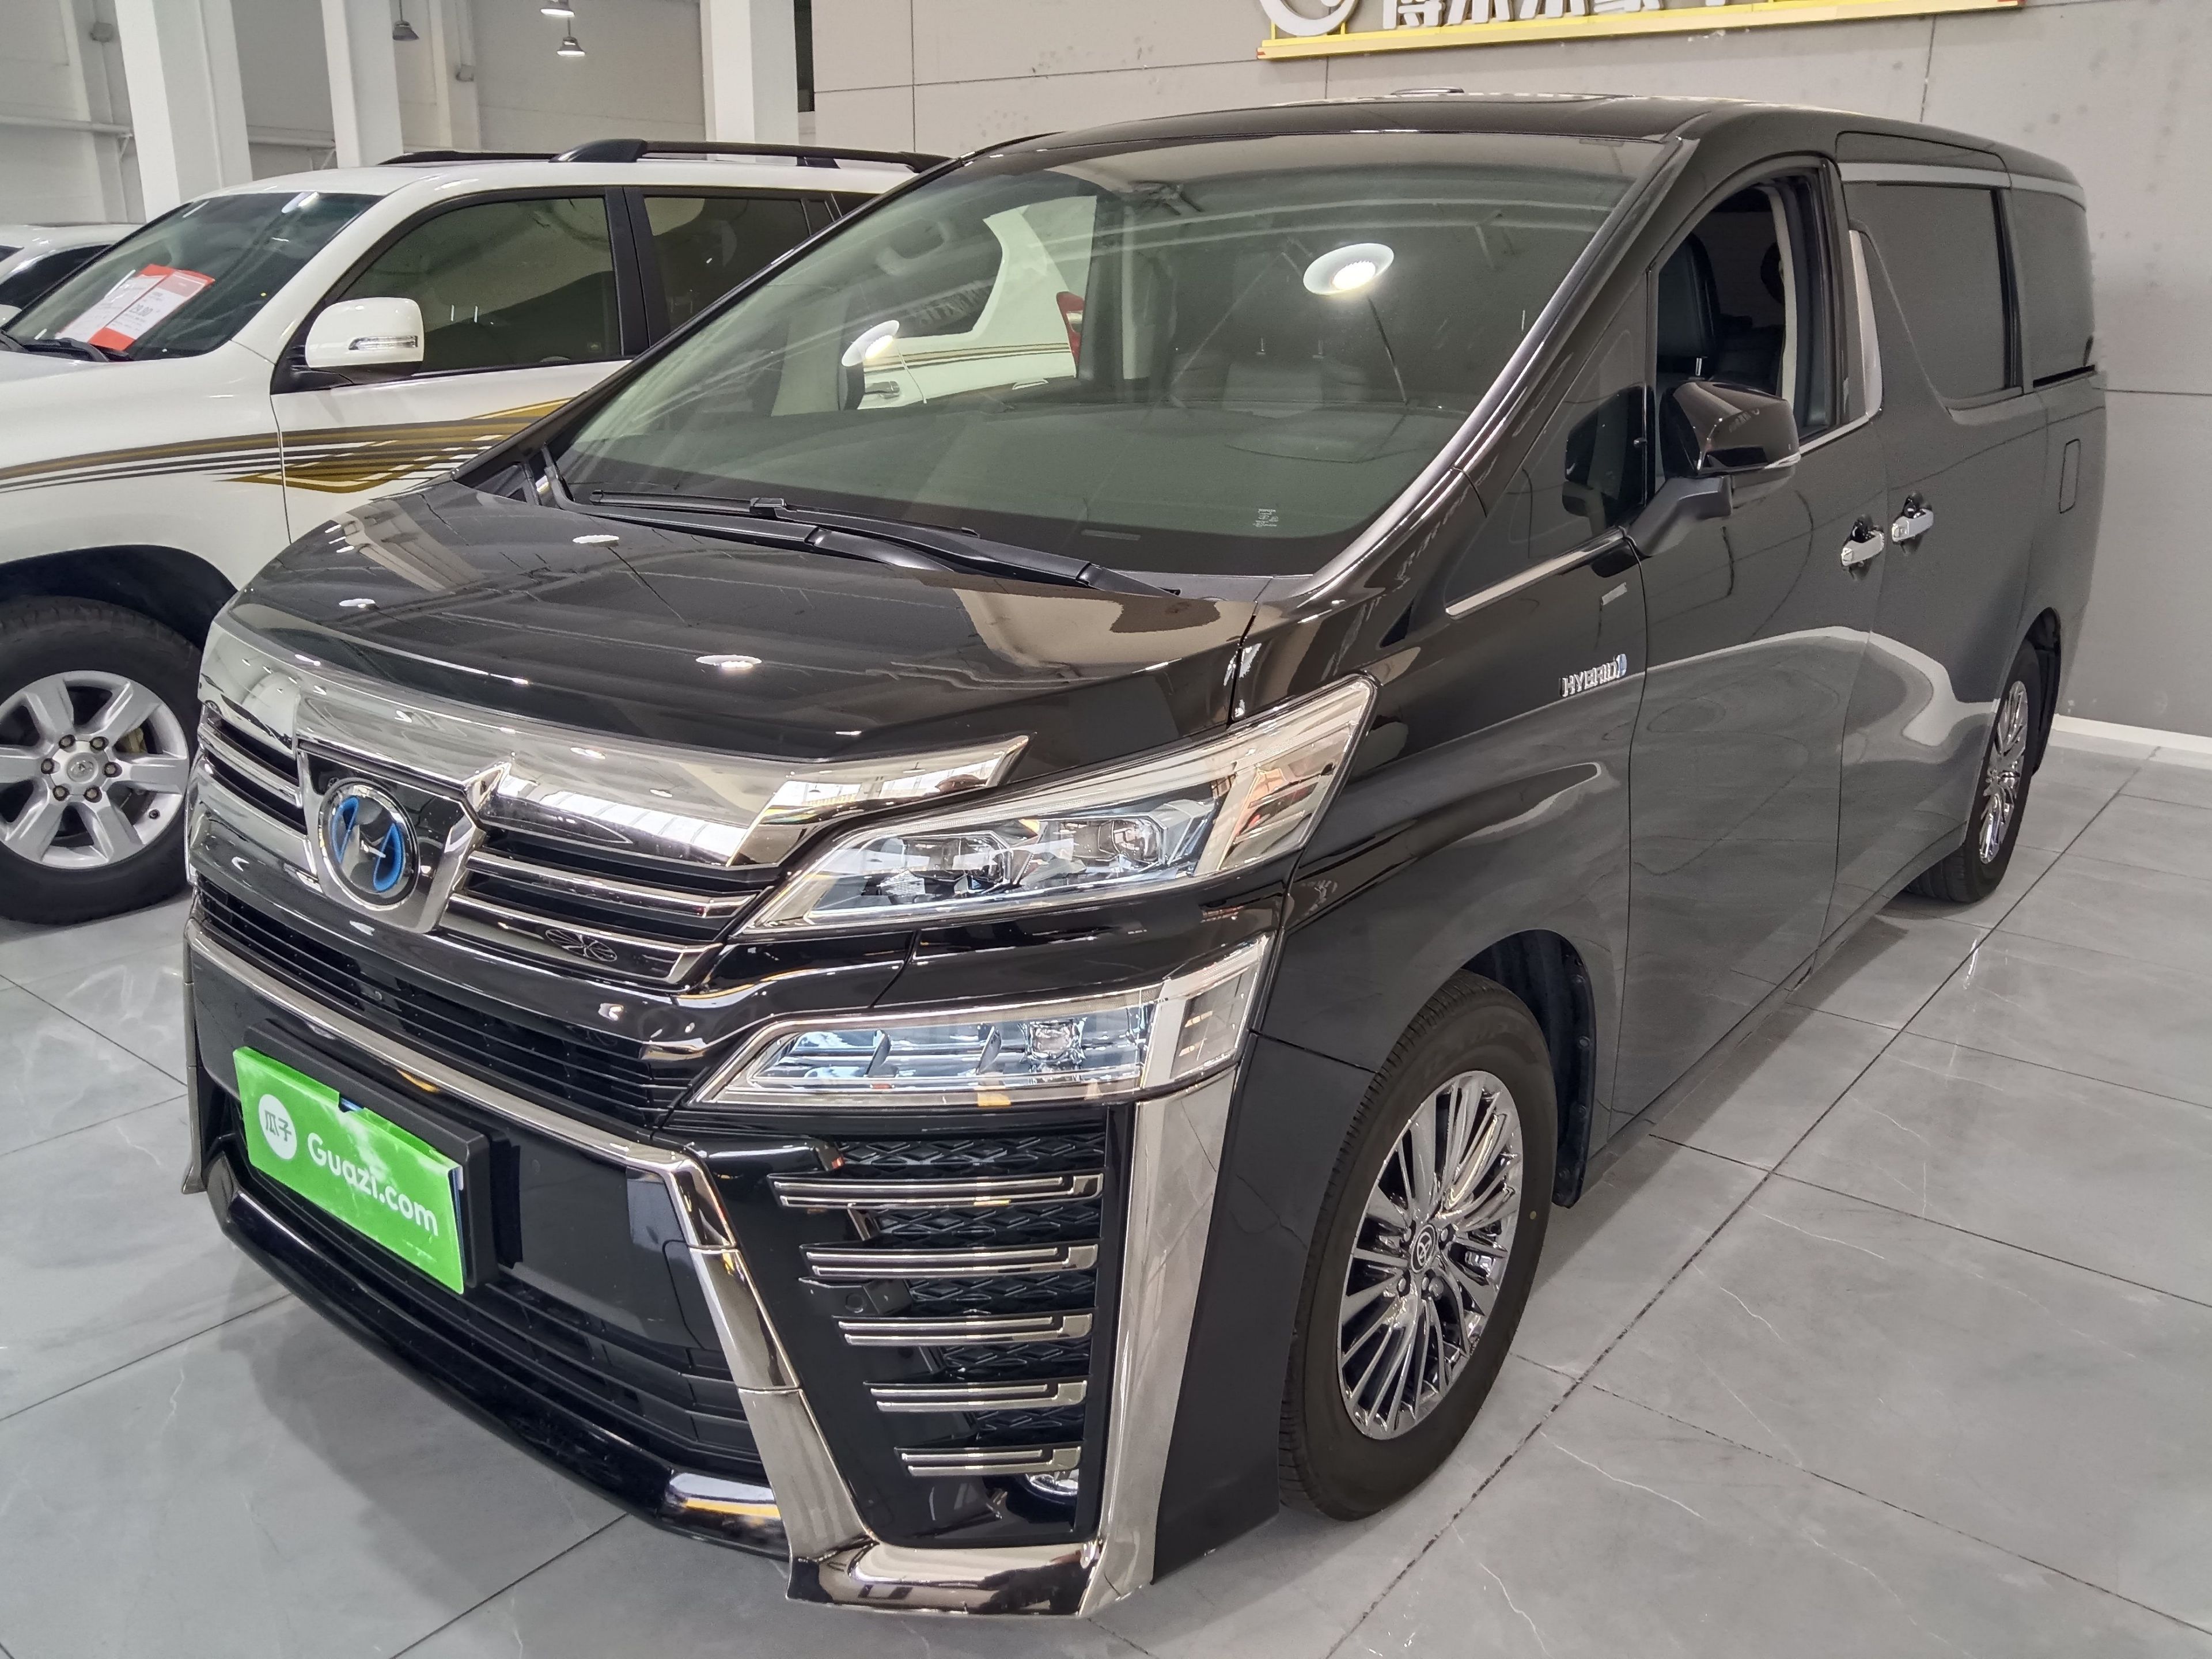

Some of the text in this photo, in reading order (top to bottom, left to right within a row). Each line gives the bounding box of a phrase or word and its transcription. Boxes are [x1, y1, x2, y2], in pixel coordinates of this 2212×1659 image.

[1561, 661, 1619, 698] HYBRID
[264, 1110, 292, 1143] 瓜子
[308, 1132, 438, 1236] Guazi.com
